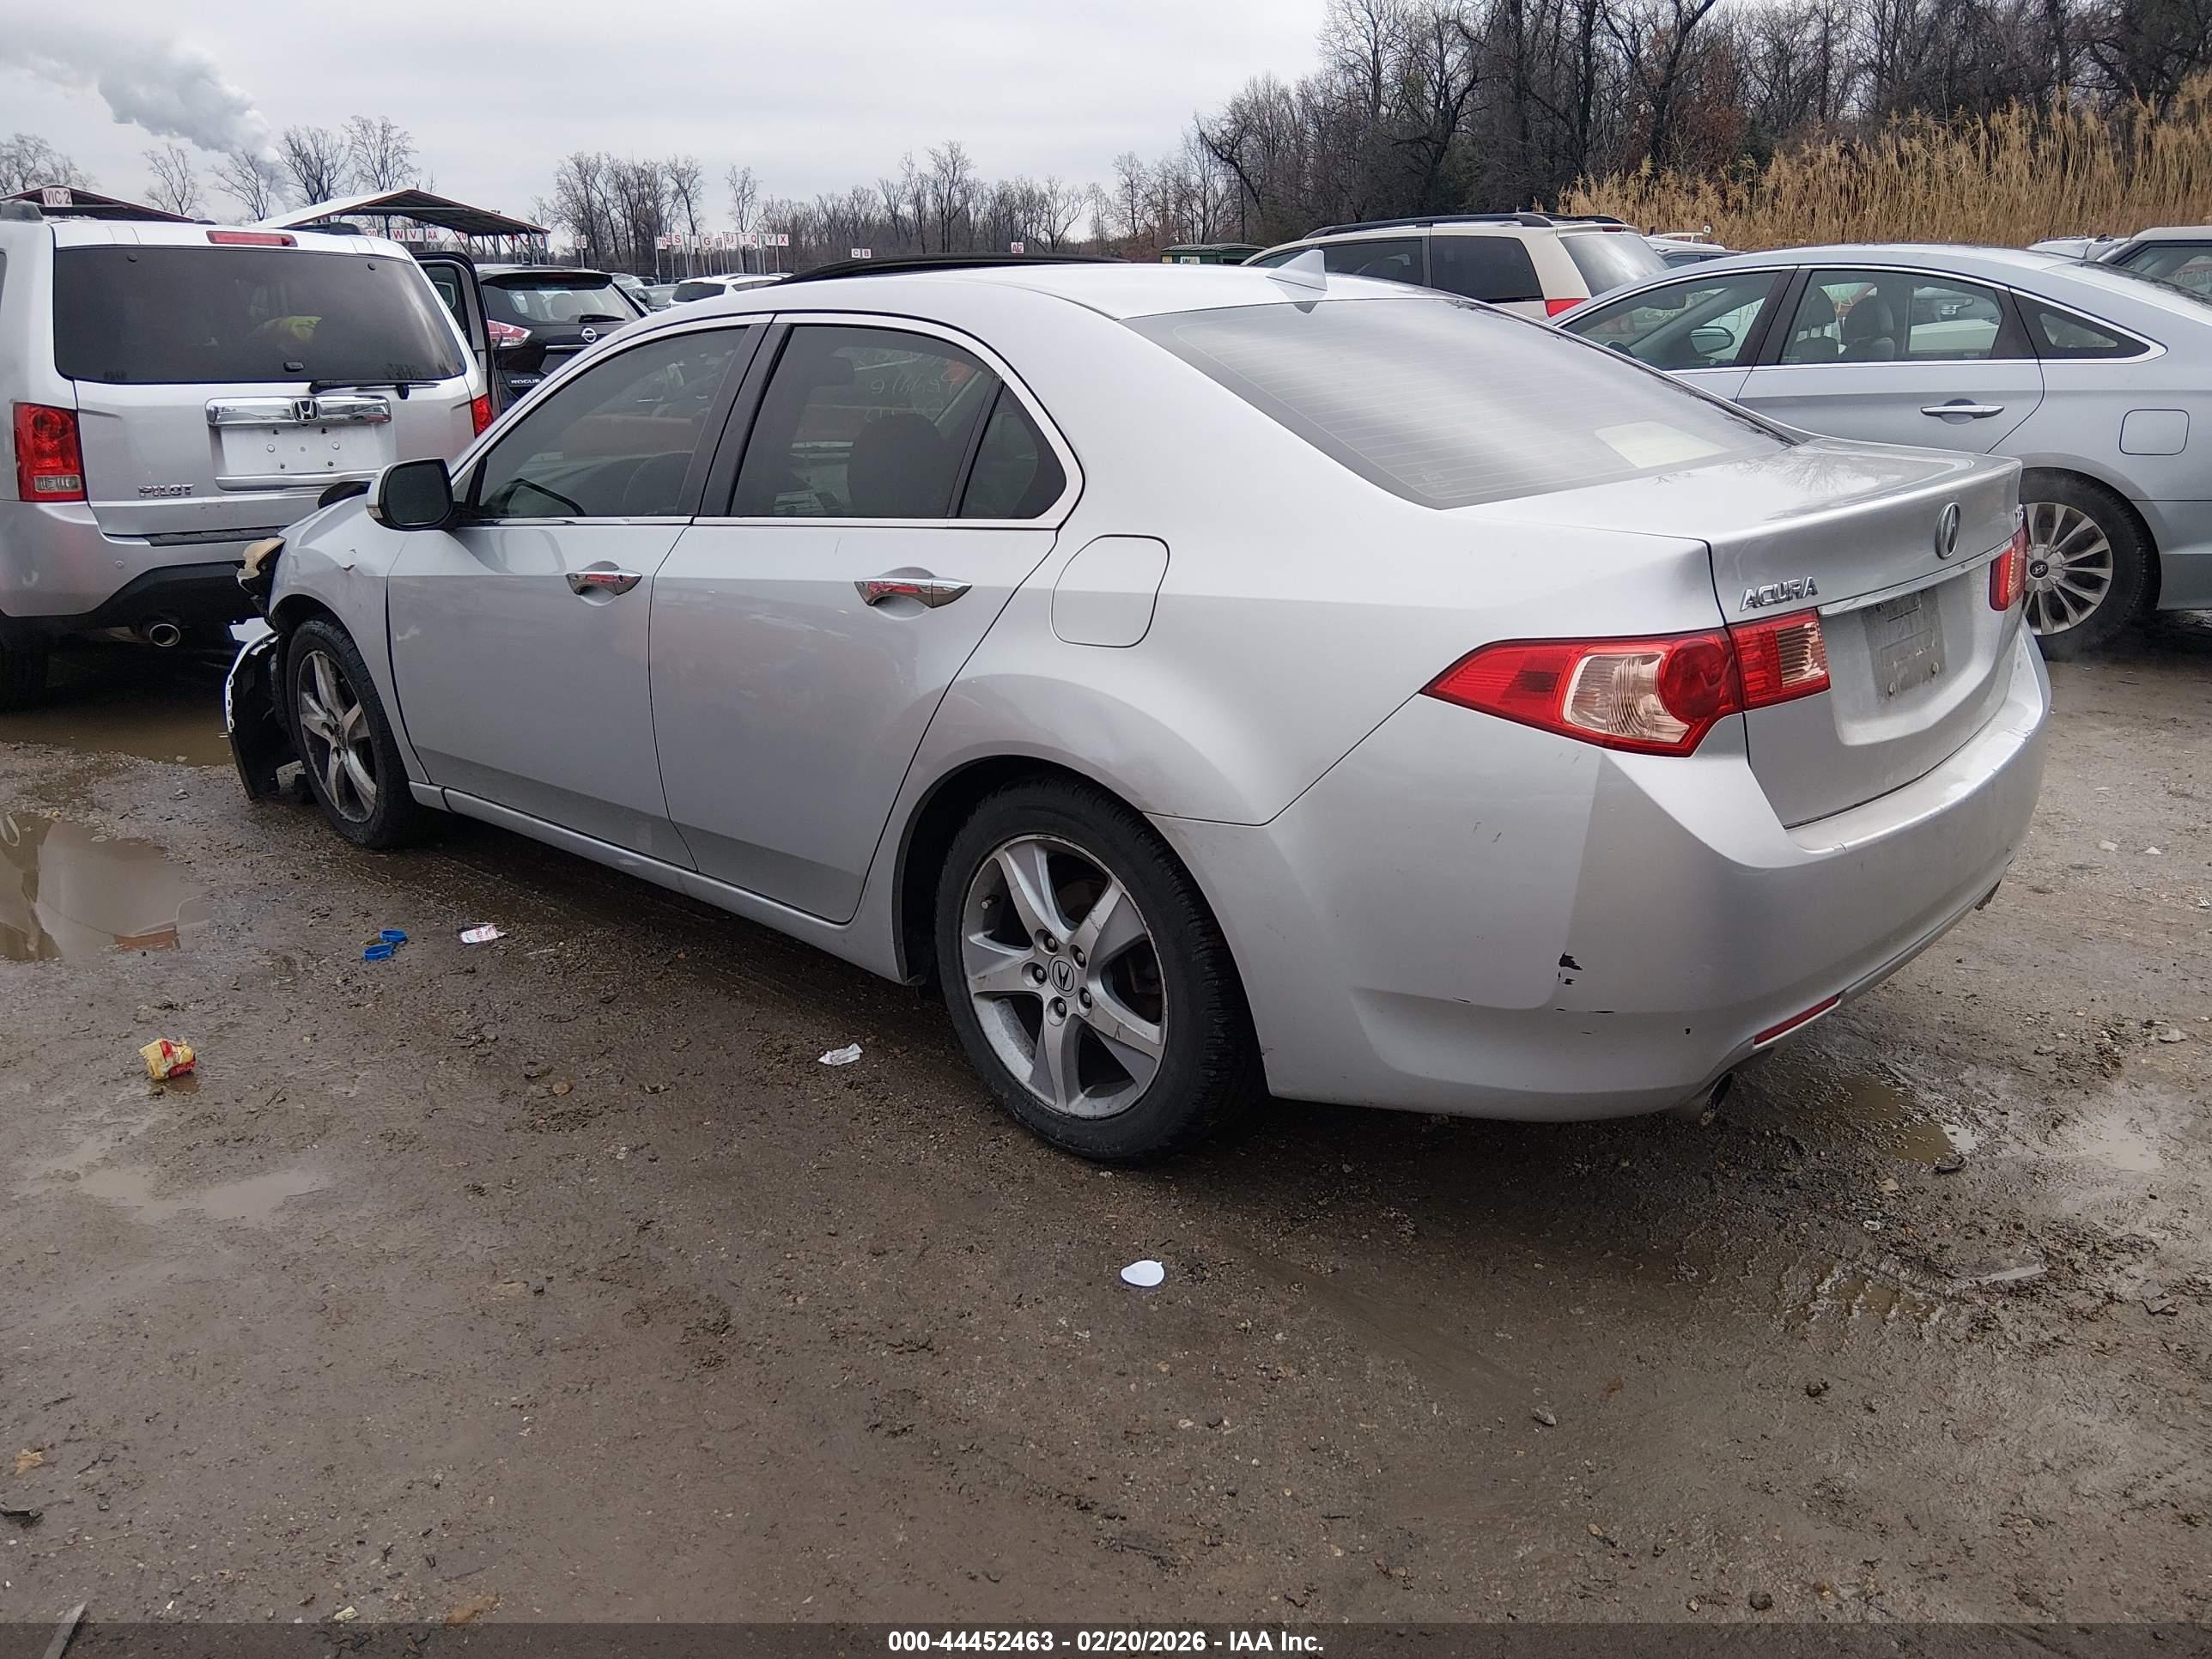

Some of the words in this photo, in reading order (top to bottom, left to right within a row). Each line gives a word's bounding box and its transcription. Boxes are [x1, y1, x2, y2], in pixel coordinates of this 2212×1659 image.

[43, 191, 62, 205] VIC
[64, 191, 71, 204] 2
[393, 230, 403, 240] W
[409, 230, 417, 240] V
[428, 230, 439, 240] AA
[674, 234, 681, 244] S
[741, 234, 747, 243] T
[767, 235, 774, 244] Y
[780, 235, 787, 244] X
[658, 239, 666, 247] 70
[703, 237, 711, 246] G
[137, 483, 194, 498] PILOT
[1739, 576, 1819, 612] ACURA
